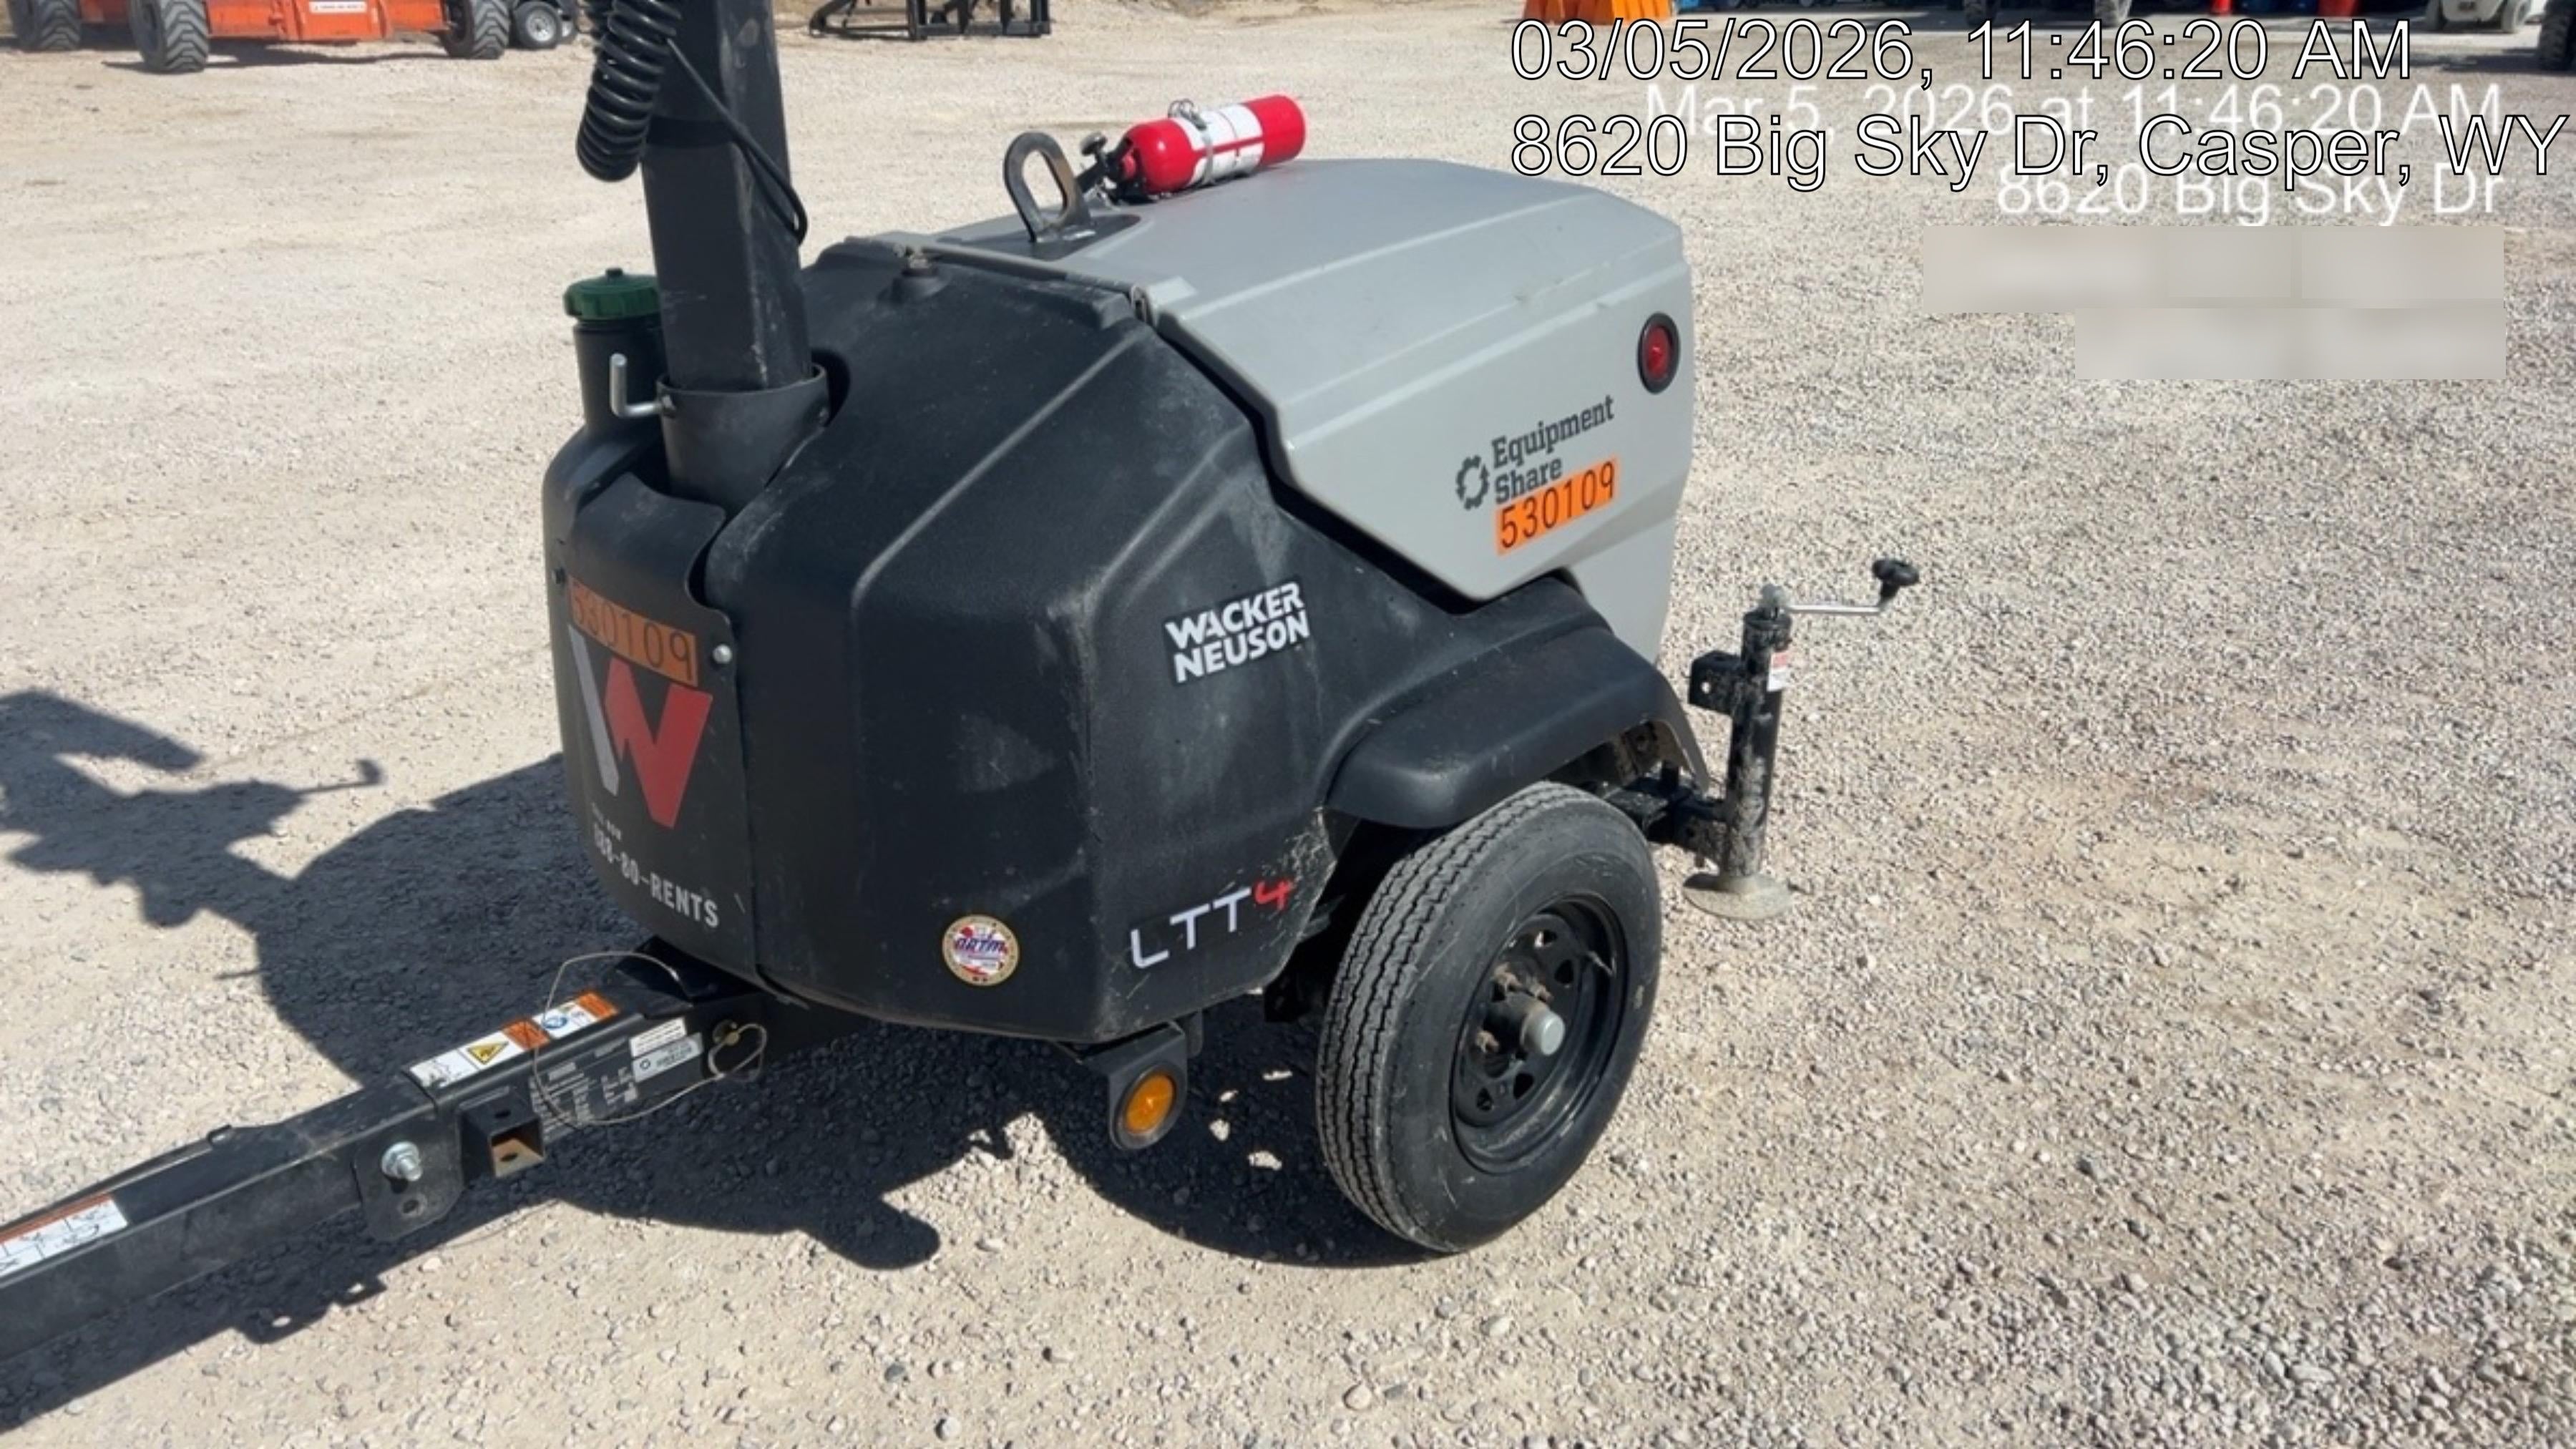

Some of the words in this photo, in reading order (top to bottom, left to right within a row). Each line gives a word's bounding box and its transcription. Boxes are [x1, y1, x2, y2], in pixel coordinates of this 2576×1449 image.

[1492, 394, 1614, 469] Equipment
[1494, 457, 1563, 505] Share
[1502, 460, 1616, 549] 530109
[1165, 582, 1304, 650] WACKER
[1174, 610, 1311, 683] NEUSON
